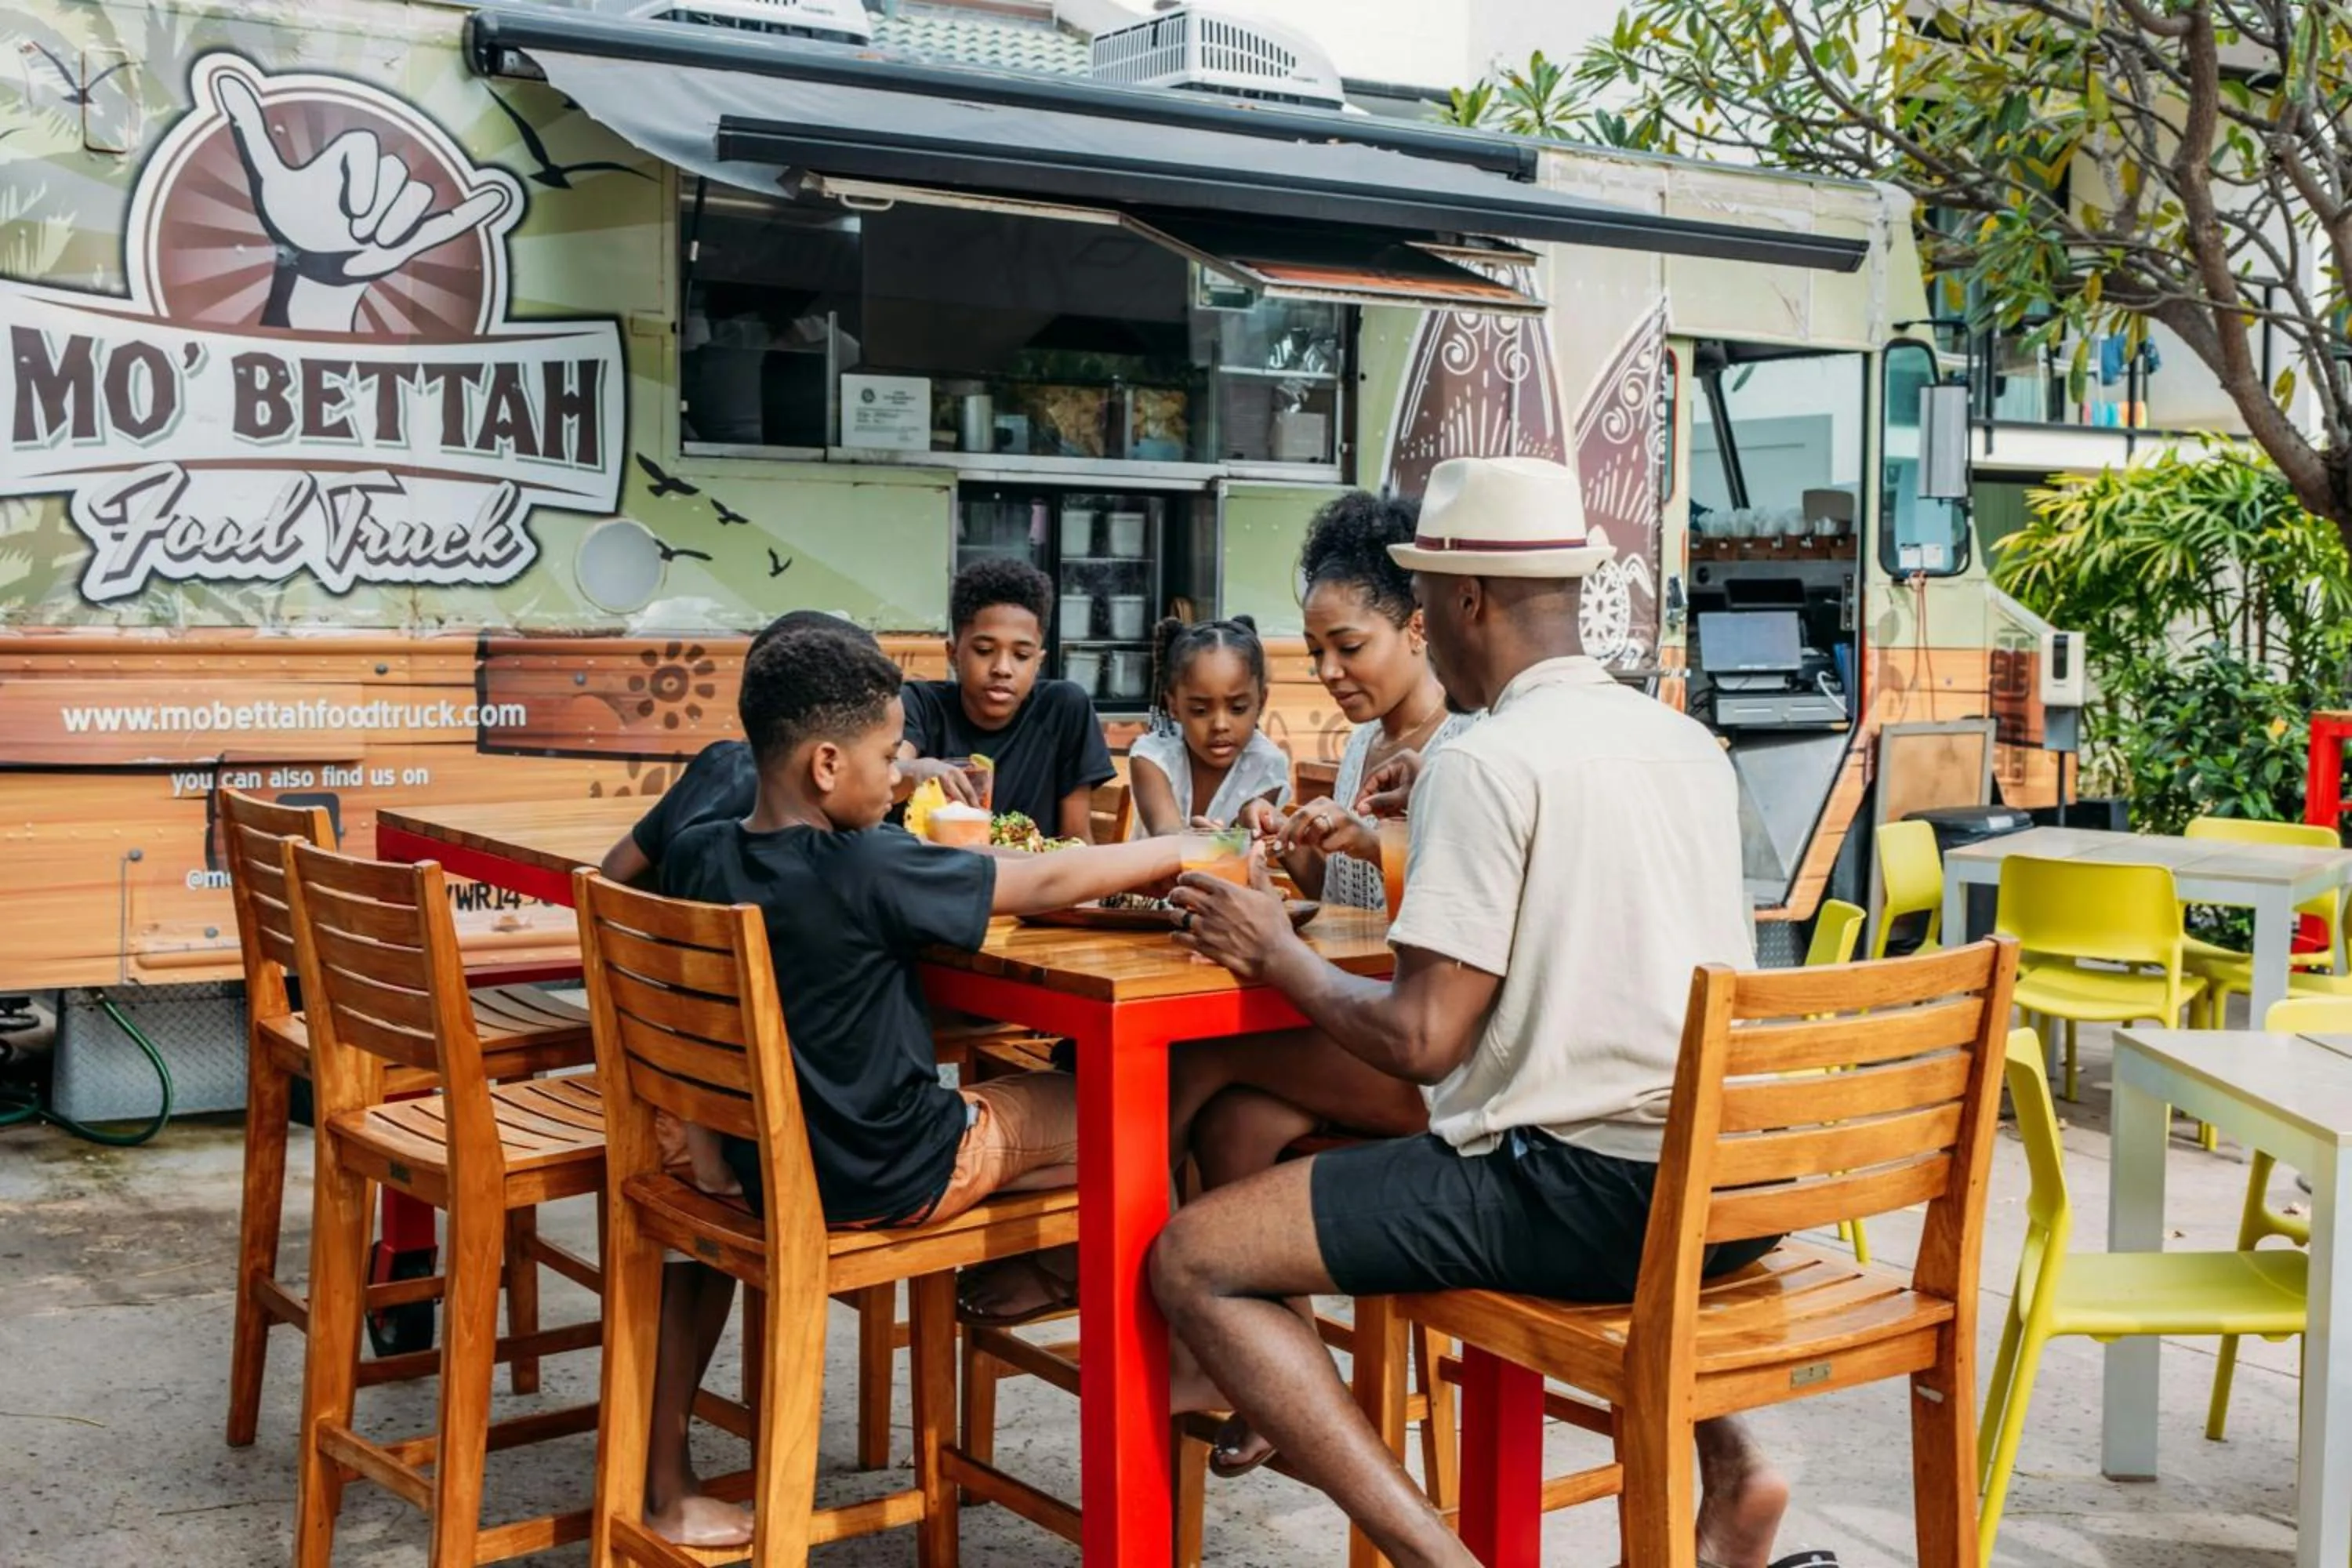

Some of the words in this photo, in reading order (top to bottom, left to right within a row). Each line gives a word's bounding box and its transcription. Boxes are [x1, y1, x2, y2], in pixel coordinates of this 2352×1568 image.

[230, 352, 606, 470] BETTAH
[89, 463, 315, 583] Food
[316, 470, 523, 575] Truck
[62, 699, 527, 731] www.mobettahfoodtruck.com
[171, 772, 213, 797] you
[221, 771, 262, 789] can
[269, 767, 314, 788] also
[321, 765, 363, 787] find
[370, 767, 396, 787] us
[402, 767, 429, 786] on
